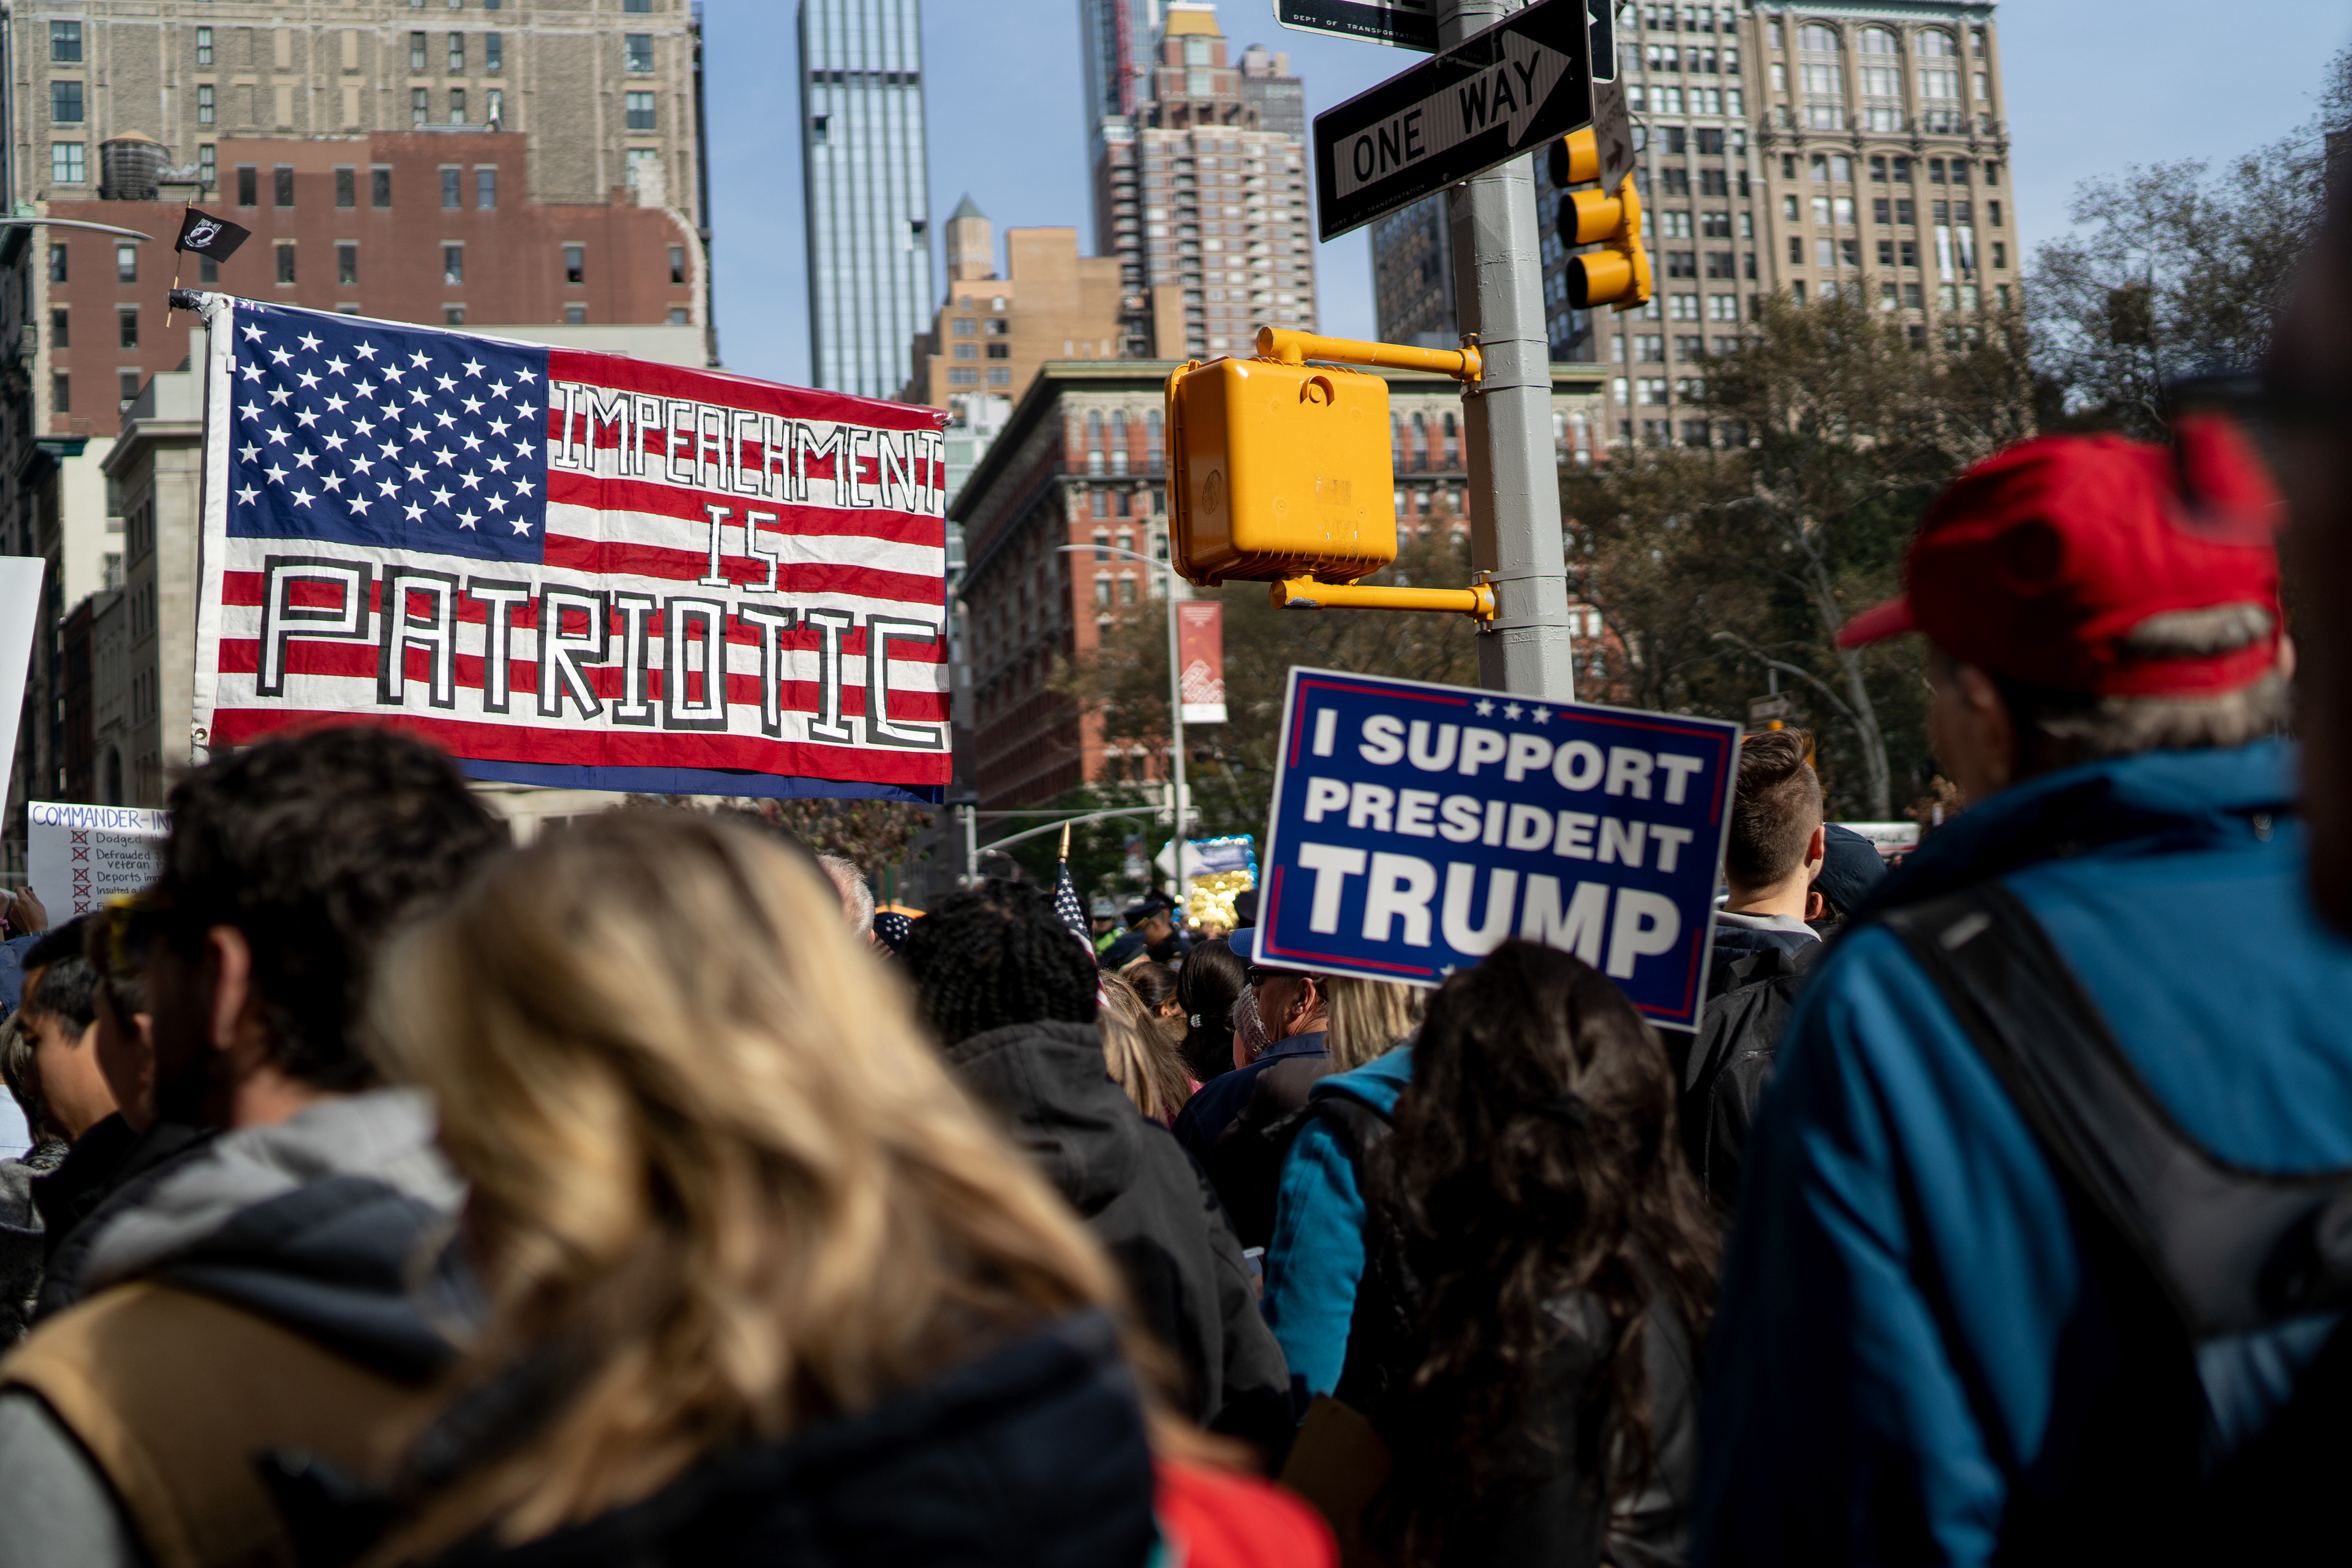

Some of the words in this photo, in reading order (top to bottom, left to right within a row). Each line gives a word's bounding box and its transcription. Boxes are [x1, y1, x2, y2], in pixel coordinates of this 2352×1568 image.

[1293, 13, 1317, 23] DEPT
[1346, 23, 1425, 42] TRANSPORTATION
[1352, 108, 1425, 183] ONE
[1458, 49, 1541, 135] WAY
[1330, 218, 1347, 229] DEPT
[1366, 183, 1425, 213] TRANSPORTATION
[554, 379, 943, 512] IMPEACHMENT
[698, 502, 780, 594] IS
[255, 554, 944, 750] PATRIOTIC
[1313, 708, 1338, 757] I
[1358, 714, 1704, 805] SUPPORT
[96, 832, 141, 847] Dodged
[96, 848, 151, 860] Defrauded
[1303, 776, 1694, 873] PRESIDENT
[97, 871, 141, 883] Deports
[97, 886, 129, 895] Insulted
[107, 861, 150, 869] veteran
[1297, 842, 1682, 980] TRUMP
